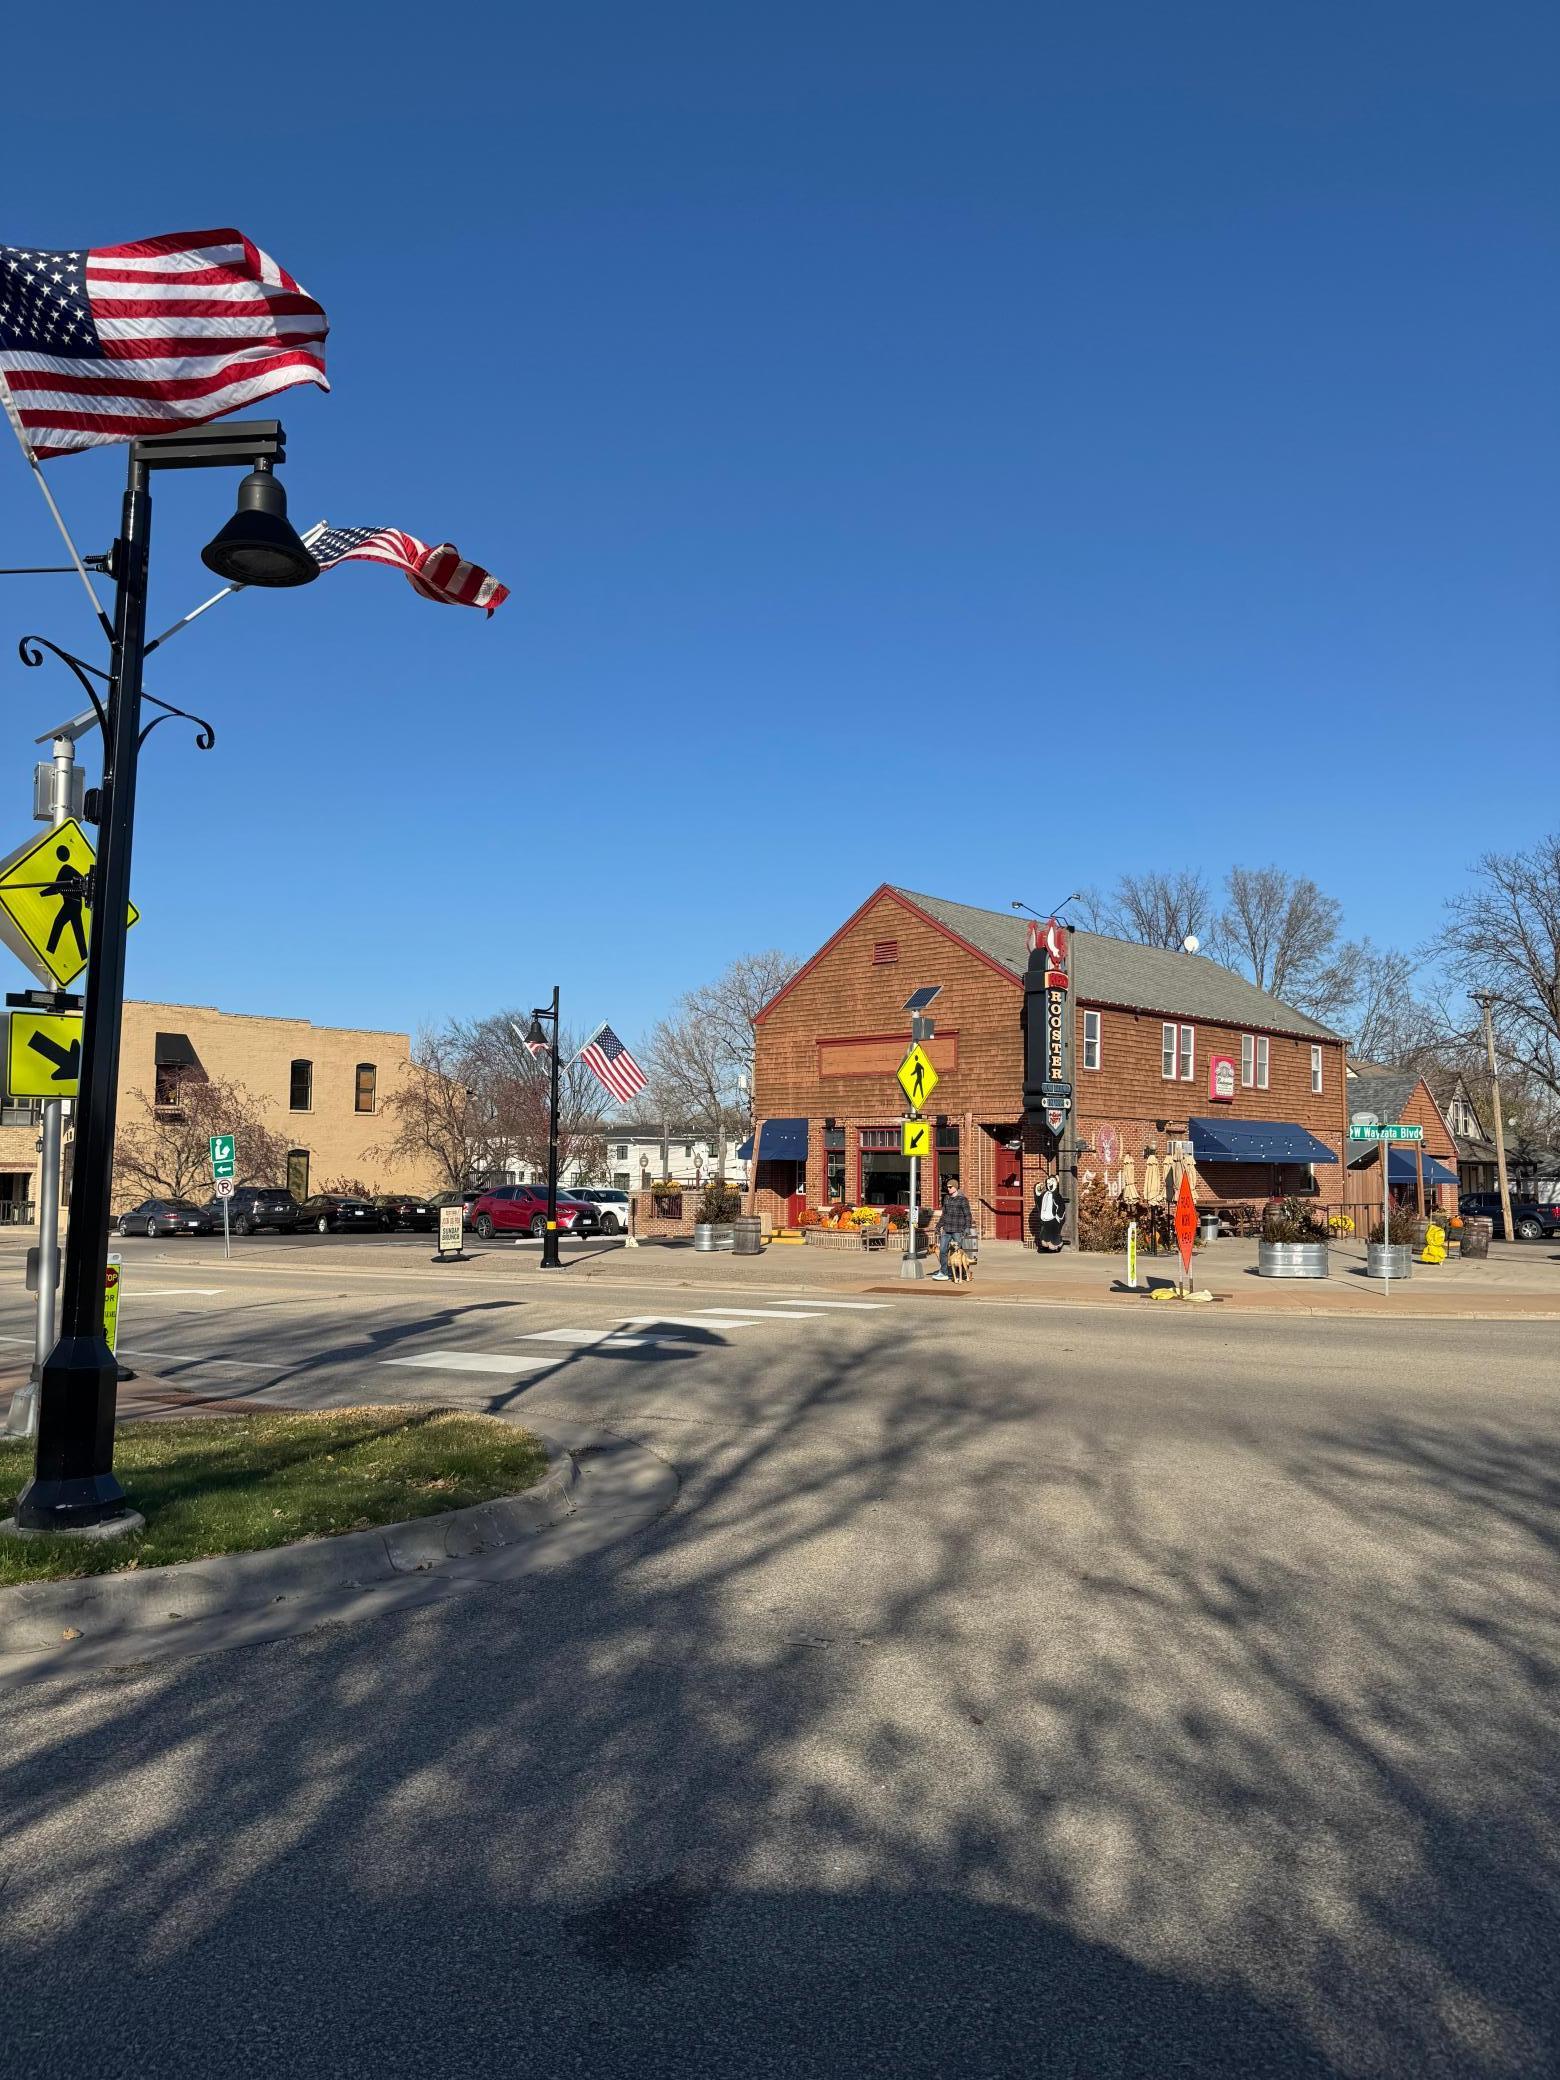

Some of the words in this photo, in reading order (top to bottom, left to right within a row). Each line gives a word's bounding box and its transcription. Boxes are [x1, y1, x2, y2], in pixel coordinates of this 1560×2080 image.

[1050, 991, 1062, 1079] ROOSTER
[1353, 1127, 1361, 1138] W
[1364, 1127, 1397, 1139] Wayzata
[1400, 1127, 1419, 1138] Blvd
[106, 1273, 118, 1282] TOP
[104, 1294, 115, 1302] OR
